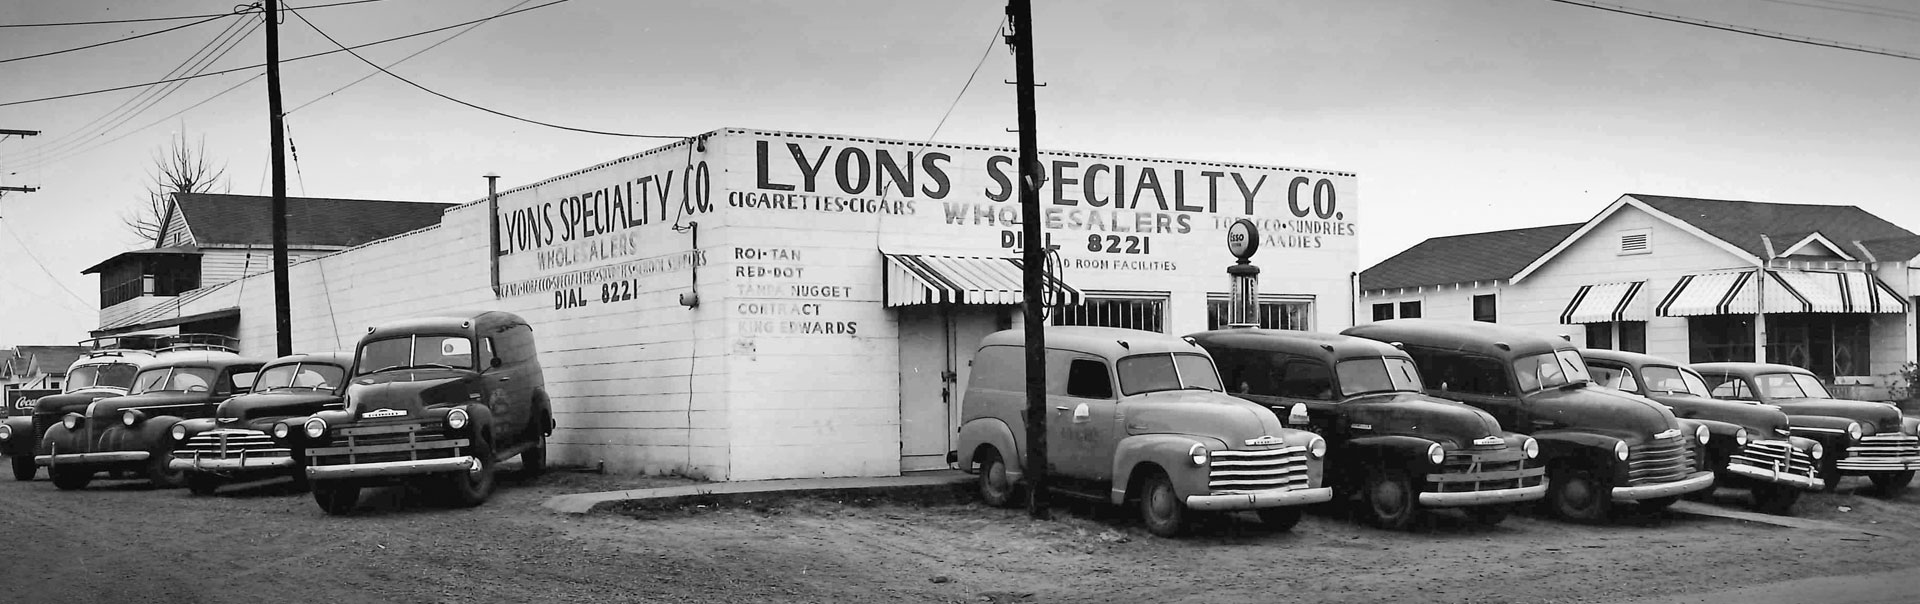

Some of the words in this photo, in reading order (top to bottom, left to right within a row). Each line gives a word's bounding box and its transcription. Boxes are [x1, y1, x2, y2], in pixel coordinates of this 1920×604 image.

[756, 141, 951, 200] LYONS
[1288, 176, 1343, 220] CO.
[496, 203, 554, 257] LYONS
[560, 170, 673, 242] SPECIALTY
[683, 161, 714, 215] CO.
[941, 202, 1191, 234] WHOESALERS
[1001, 230, 1061, 251] DIL
[1087, 234, 1150, 255] 8221
[1260, 234, 1322, 249] ANDIES
[1076, 258, 1109, 269] ROOM
[1113, 259, 1177, 271] FACILITIES
[555, 287, 588, 310] DIAL
[602, 278, 638, 304] 8221
[791, 285, 852, 299] NUGGET
[780, 321, 857, 335] EDWARDS
